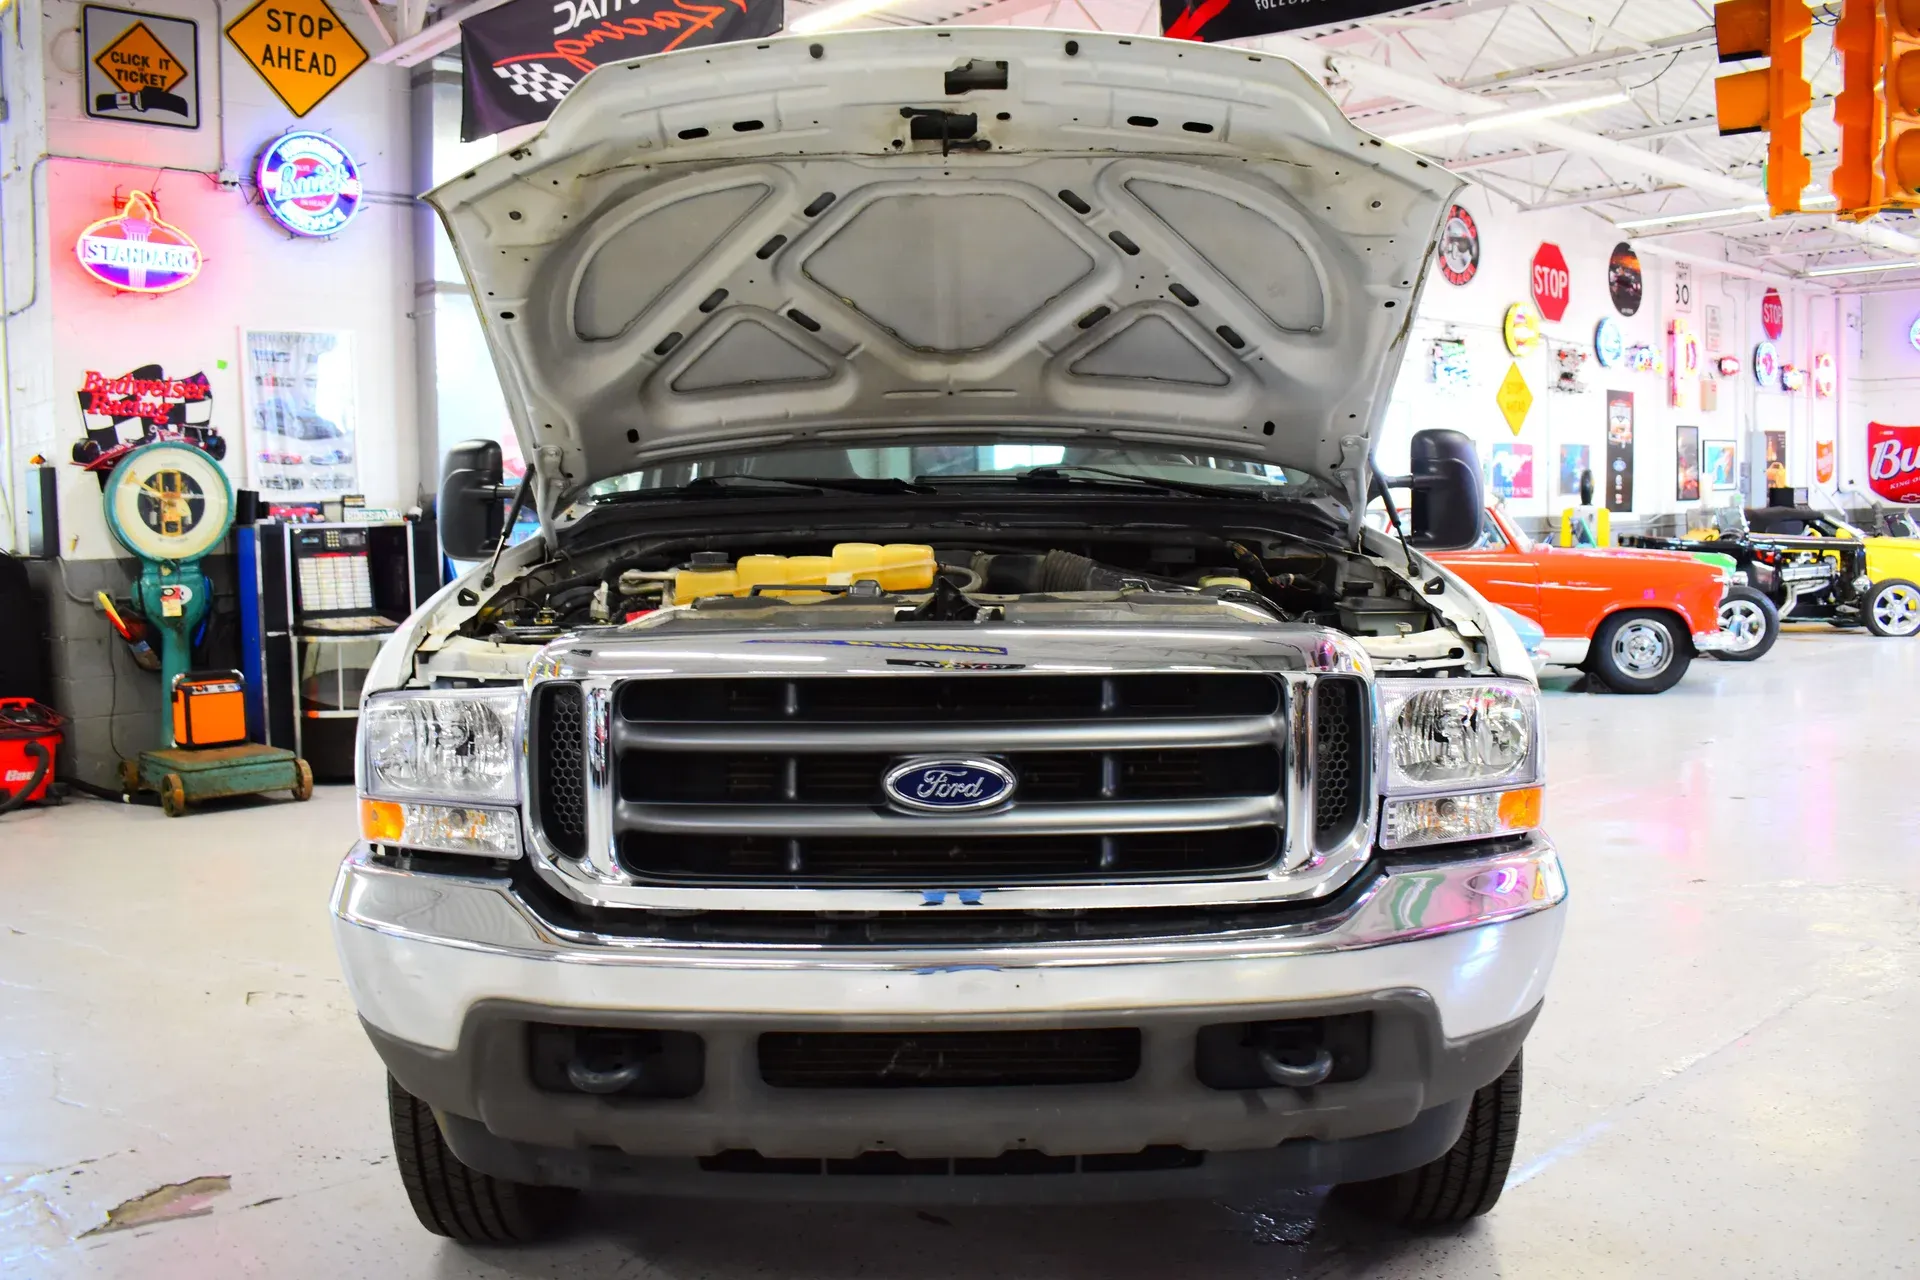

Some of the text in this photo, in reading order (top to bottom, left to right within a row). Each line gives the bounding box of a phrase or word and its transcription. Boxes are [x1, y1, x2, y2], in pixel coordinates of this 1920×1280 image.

[266, 8, 334, 40] STOP
[110, 51, 171, 71] CLICK IT
[261, 43, 337, 77] AHEAD
[115, 68, 167, 87] TICKET
[86, 242, 194, 270] STANDARD
[1534, 264, 1568, 300] STOP
[1763, 303, 1782, 325] STOP
[82, 371, 211, 399] Budweiser
[88, 391, 174, 424] Racing
[1870, 439, 1920, 480] Bu
[1890, 479, 1910, 490] KING
[917, 769, 984, 798] Ford
